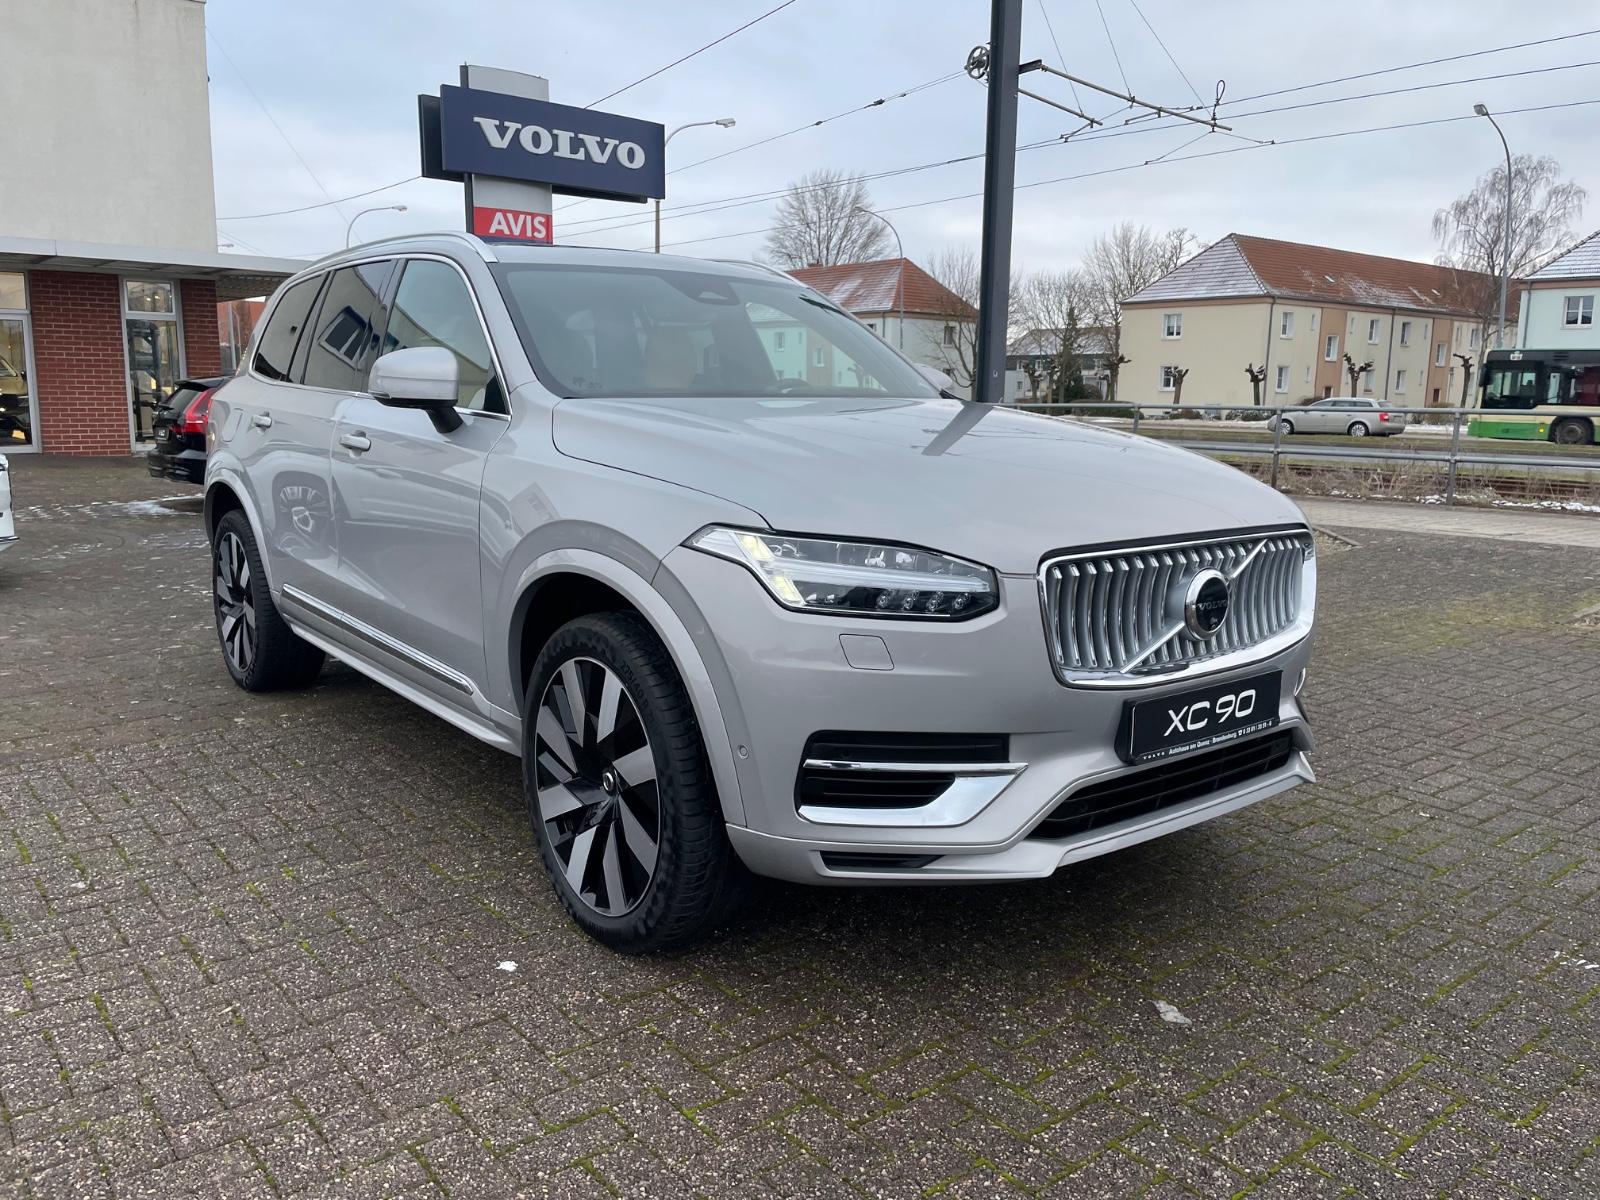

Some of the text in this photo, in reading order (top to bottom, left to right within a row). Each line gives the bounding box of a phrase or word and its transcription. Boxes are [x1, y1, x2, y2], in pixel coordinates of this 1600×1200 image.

[473, 116, 646, 170] VOLVO
[489, 211, 547, 239] AVIS
[1163, 701, 1210, 737] XC
[1215, 689, 1256, 723] 90
